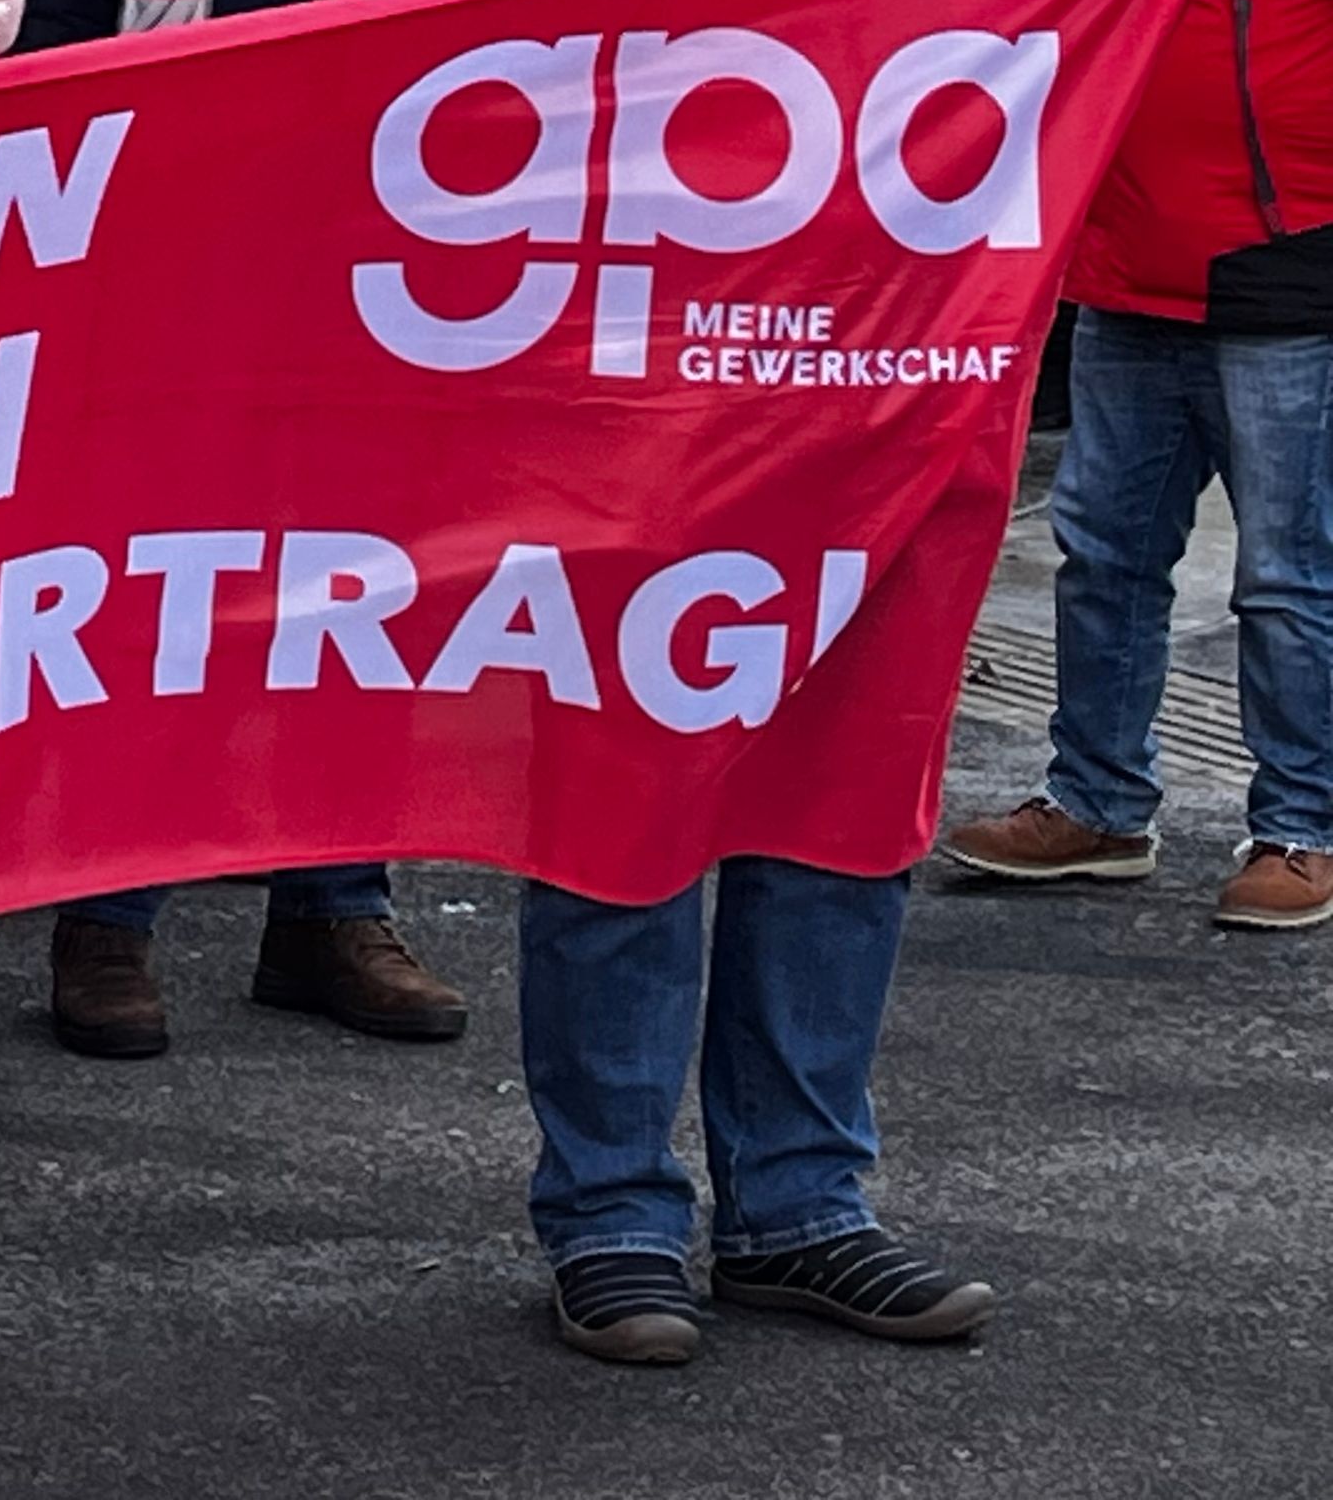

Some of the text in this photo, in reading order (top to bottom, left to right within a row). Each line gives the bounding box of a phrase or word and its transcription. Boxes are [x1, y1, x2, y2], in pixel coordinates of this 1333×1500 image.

[351, 26, 1061, 379] gpa
[682, 301, 835, 343] MEINE
[677, 345, 1023, 387] GEWERKSCHAF
